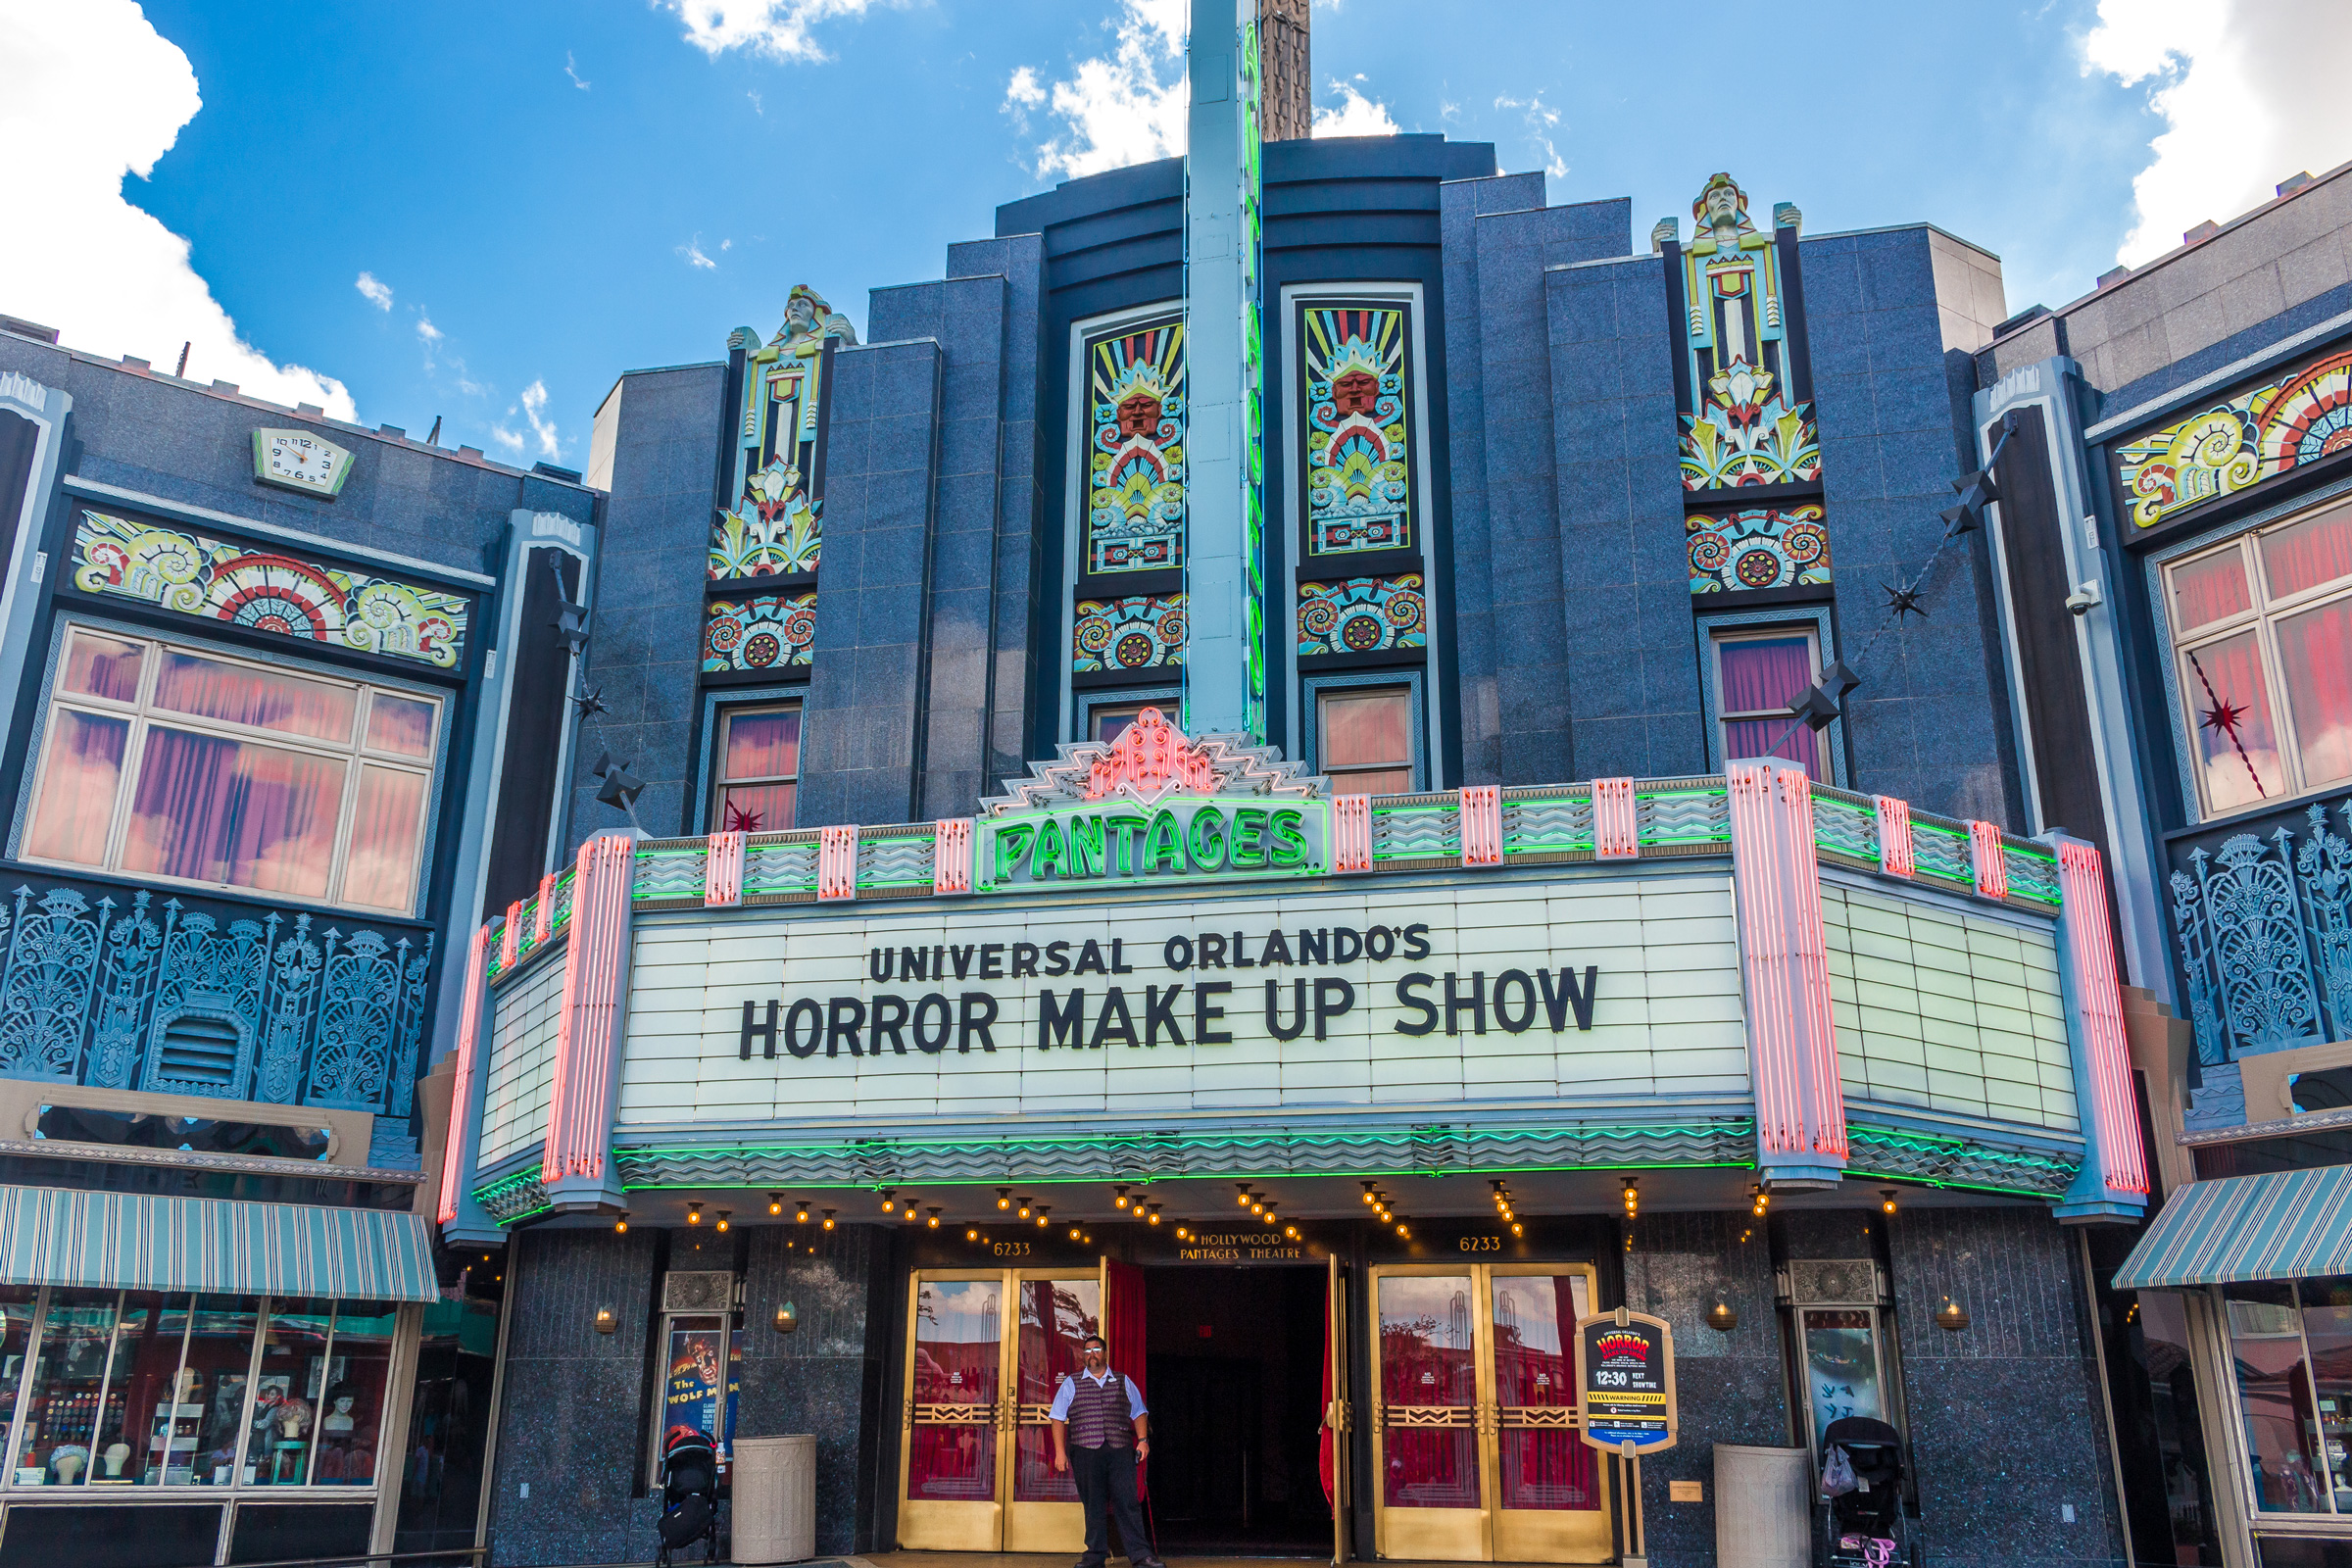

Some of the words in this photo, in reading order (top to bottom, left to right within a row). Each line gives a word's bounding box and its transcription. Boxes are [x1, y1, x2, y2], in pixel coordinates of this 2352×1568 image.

[300, 439, 312, 449] 12
[322, 461, 331, 469] 3
[994, 806, 1310, 881] PANTAGES
[870, 937, 1133, 983] UNIVERSAL
[1163, 922, 1432, 971] ORLANDO'S
[738, 992, 1000, 1060] HORROR
[1038, 980, 1233, 1051] MAKE
[1264, 977, 1355, 1042] UP
[1394, 965, 1598, 1038] SHOW
[1200, 1234, 1281, 1246] HOLLYWOOD
[1460, 1236, 1500, 1251] 6233
[994, 1242, 1031, 1256] 6233
[1180, 1249, 1240, 1259] PANTAGES
[1249, 1248, 1301, 1259] THEATRE
[1595, 1334, 1649, 1355] HORROR
[1629, 1349, 1647, 1361] SHOW
[673, 1380, 695, 1390] The
[1595, 1370, 1627, 1386] 12:30
[667, 1390, 704, 1404] WOLF
